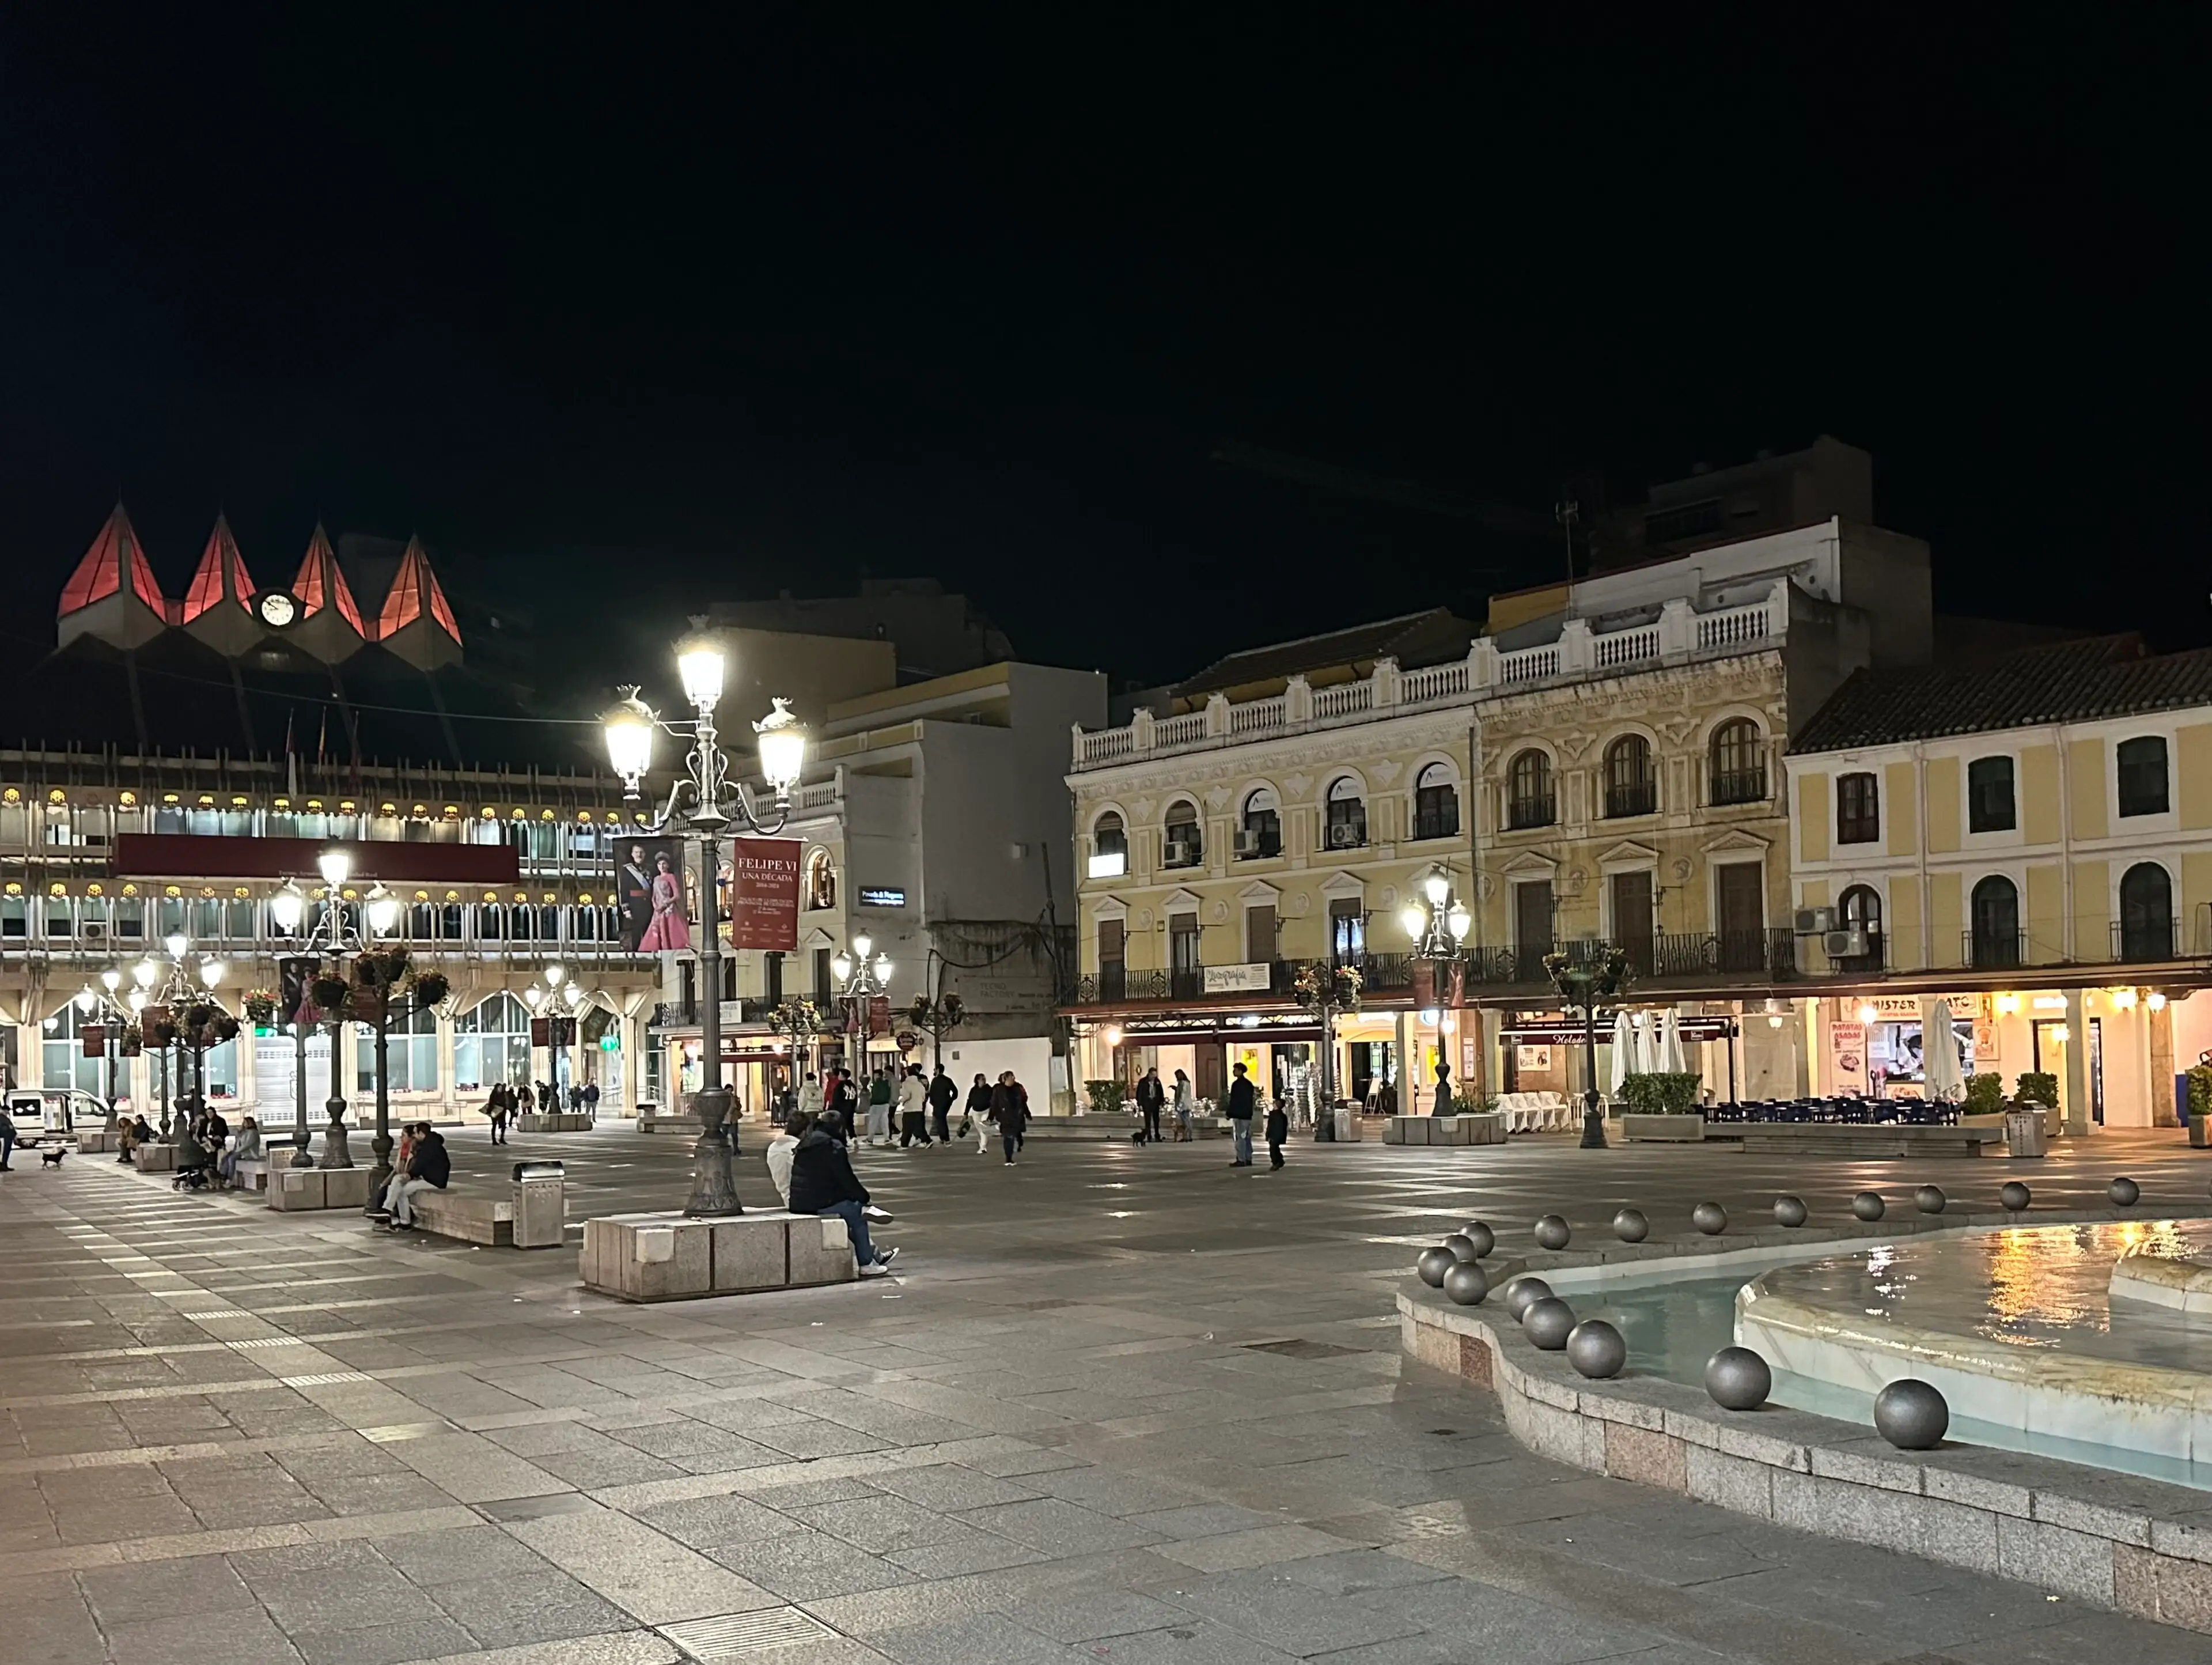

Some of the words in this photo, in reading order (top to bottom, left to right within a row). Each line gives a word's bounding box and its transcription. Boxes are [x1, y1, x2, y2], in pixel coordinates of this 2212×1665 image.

[738, 858, 782, 871] FELIPE
[786, 861, 797, 871] VI
[761, 873, 793, 882] DÉCADA
[1872, 1000, 1915, 1010] MISTER
[1945, 996, 1969, 1008] ATO
